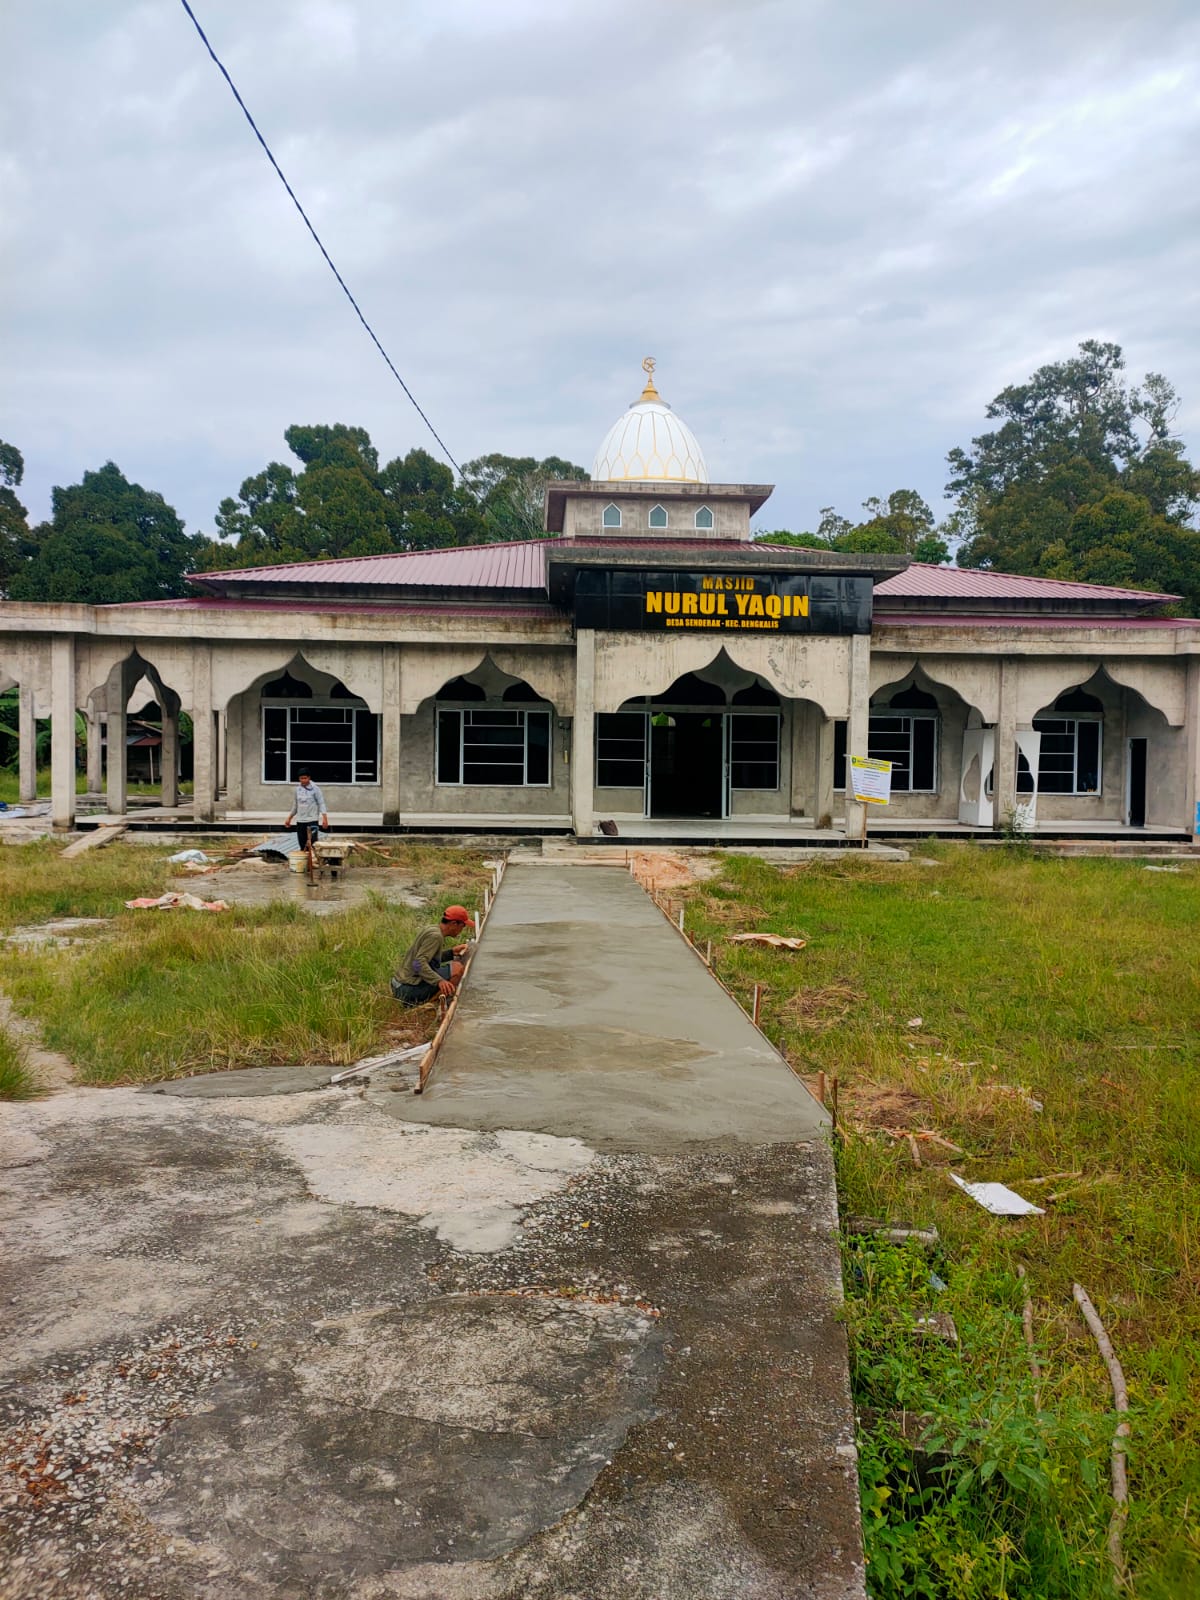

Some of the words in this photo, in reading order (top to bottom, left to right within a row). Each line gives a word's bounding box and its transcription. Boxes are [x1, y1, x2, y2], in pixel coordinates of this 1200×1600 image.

[702, 577, 755, 590] MASJID
[646, 592, 728, 614] NURUL
[735, 594, 809, 618] YAQIN
[666, 618, 684, 627] DESA
[685, 618, 721, 628] SENDERAK
[741, 619, 779, 629] BENGKALIS
